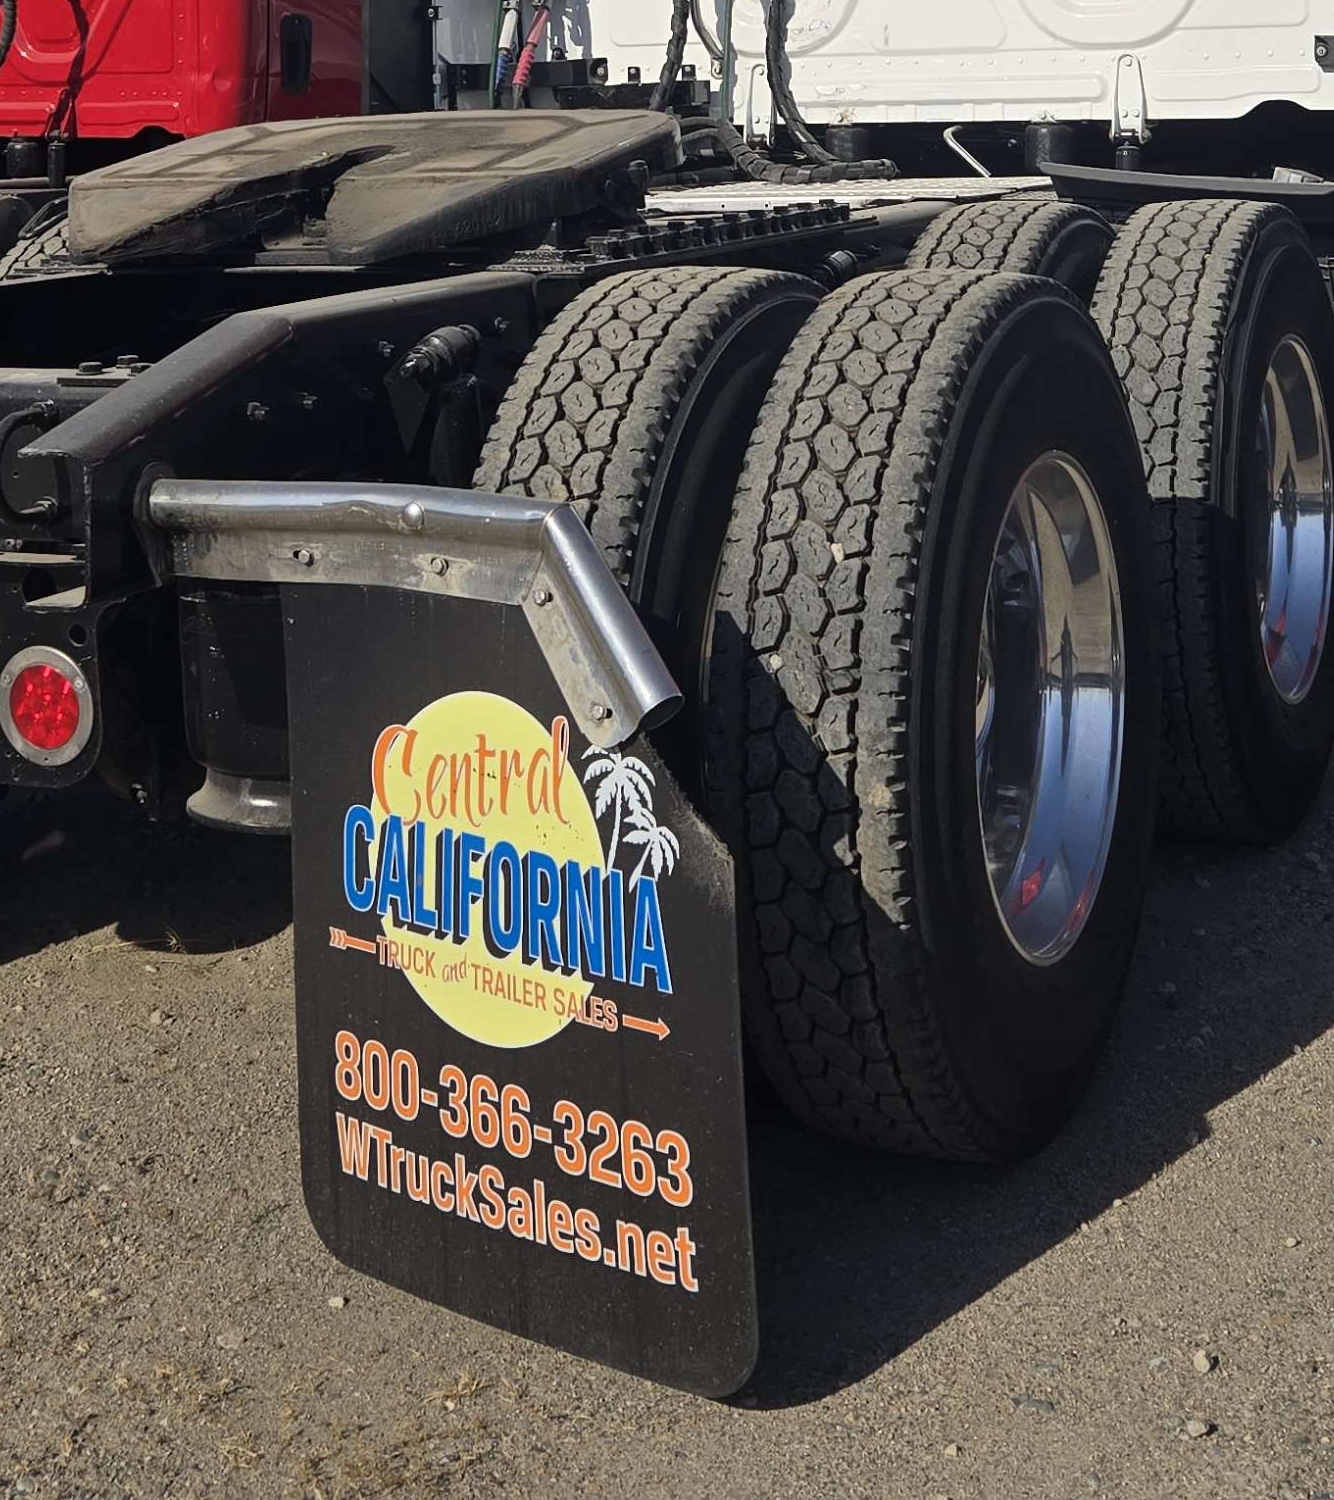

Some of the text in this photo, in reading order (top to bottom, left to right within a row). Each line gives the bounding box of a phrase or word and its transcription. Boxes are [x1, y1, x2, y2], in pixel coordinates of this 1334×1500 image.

[372, 714, 572, 826] Central
[343, 803, 673, 994] CALIFORNIA
[376, 934, 619, 1033] TRUCK and TRAILER SALES
[333, 1029, 694, 1208] 800-366-3263
[334, 1111, 700, 1292] WTruckSales.net
